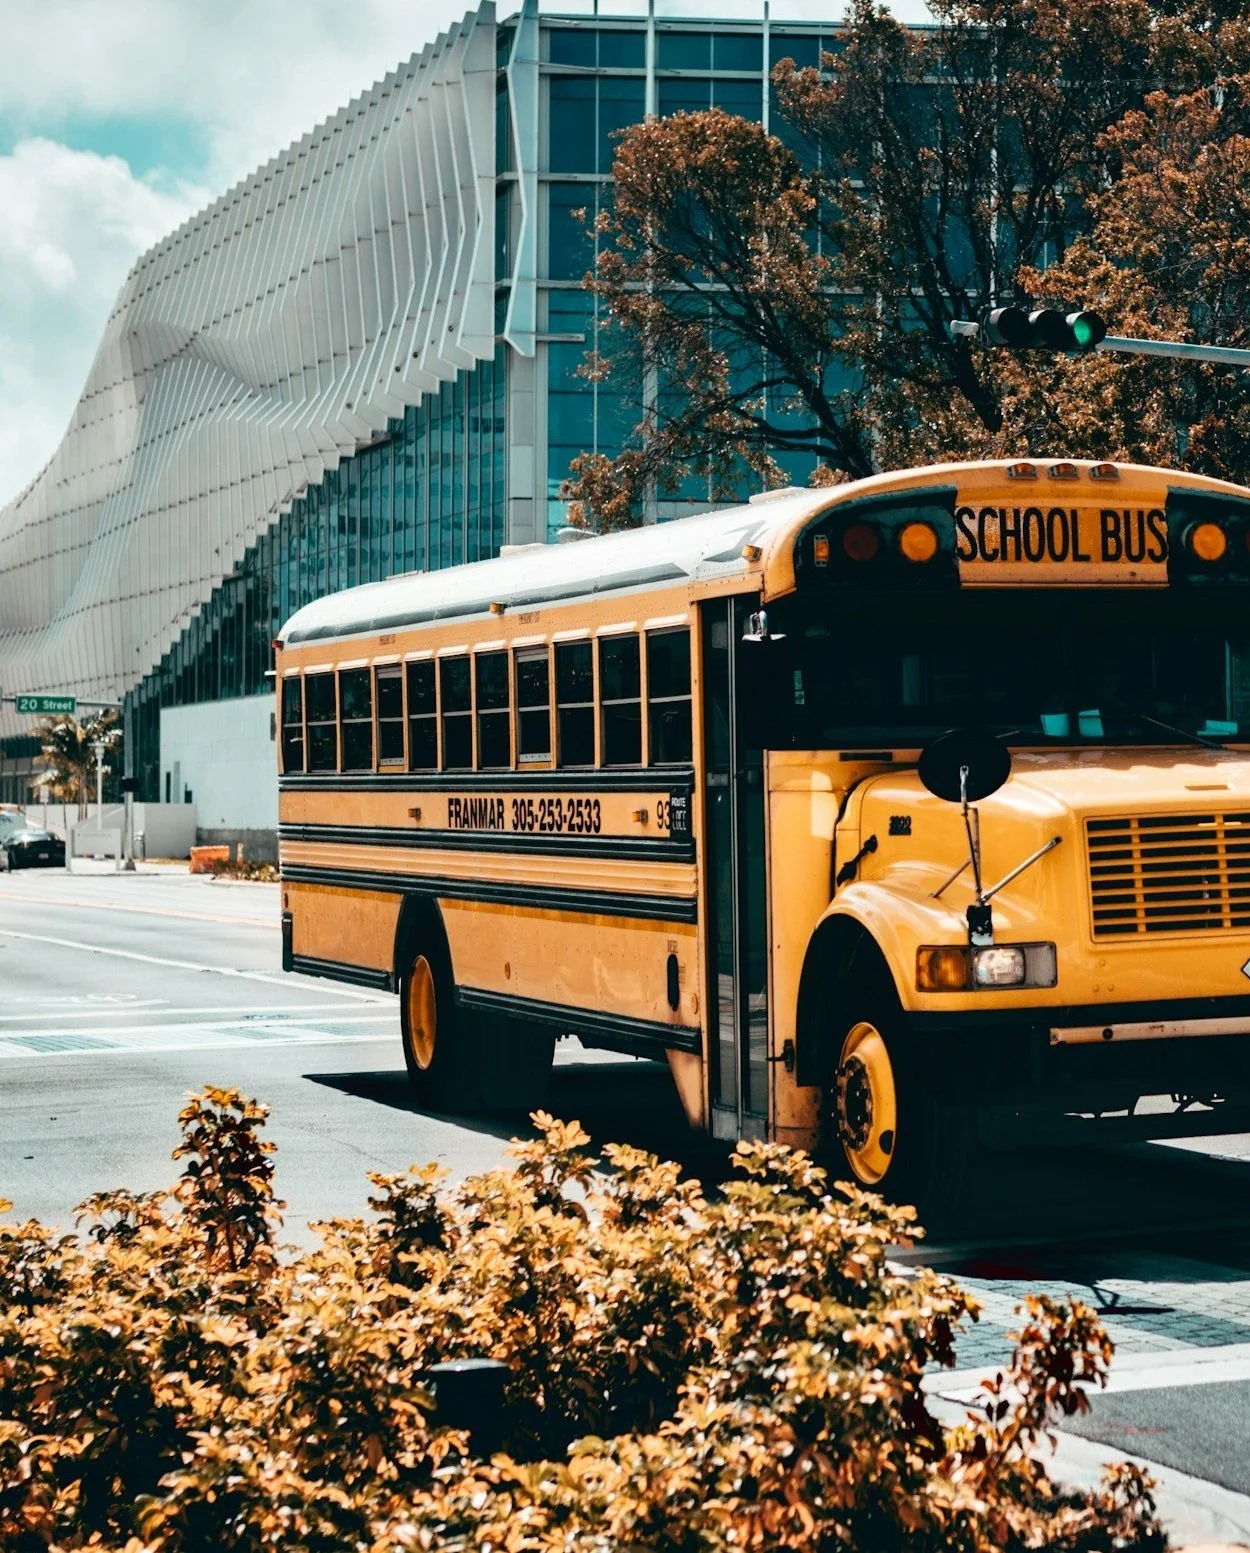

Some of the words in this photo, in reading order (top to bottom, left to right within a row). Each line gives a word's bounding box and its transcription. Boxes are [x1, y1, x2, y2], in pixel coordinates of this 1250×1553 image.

[956, 507, 1091, 563] SCHOOL
[1101, 509, 1169, 563] BUS
[20, 698, 38, 710] 20
[42, 700, 73, 711] Street
[448, 798, 505, 830] FRANMAR
[512, 798, 601, 834] 305-253-2533
